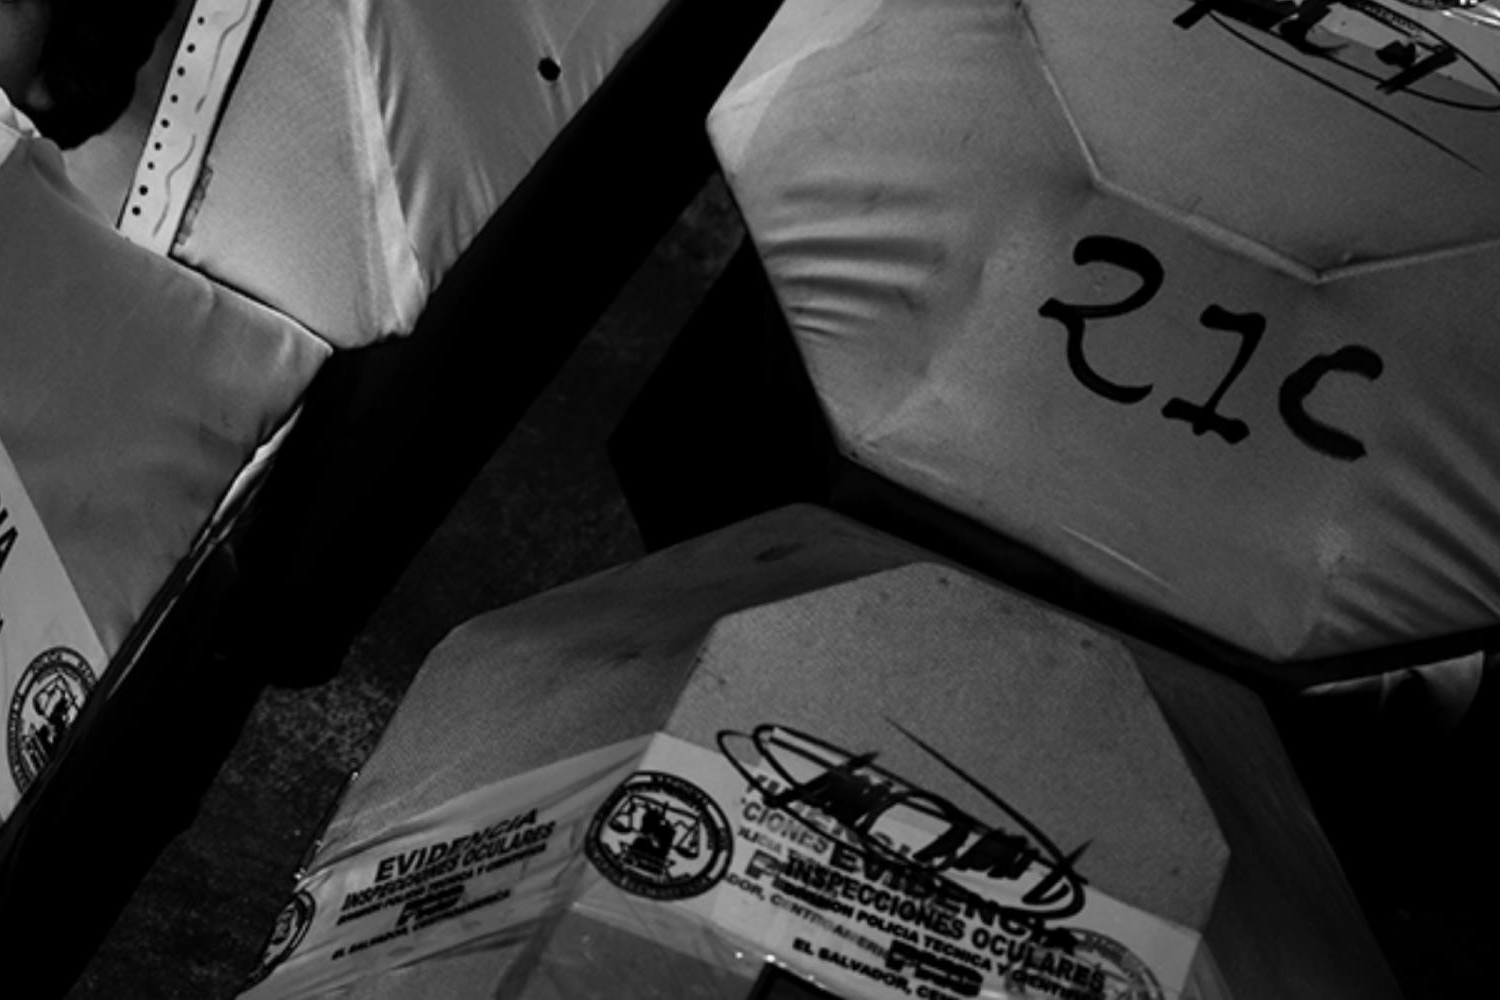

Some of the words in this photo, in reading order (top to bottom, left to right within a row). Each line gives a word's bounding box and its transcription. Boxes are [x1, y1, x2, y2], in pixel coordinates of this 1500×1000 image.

[376, 809, 539, 883] EVIDENCIA
[782, 852, 966, 941] INSPECCIONES
[971, 927, 1105, 997] OCULARES
[856, 910, 919, 944] POLICIA
[924, 935, 992, 972] TECNICA
[792, 939, 814, 953] EL
[818, 945, 911, 993] SALVADOR,
